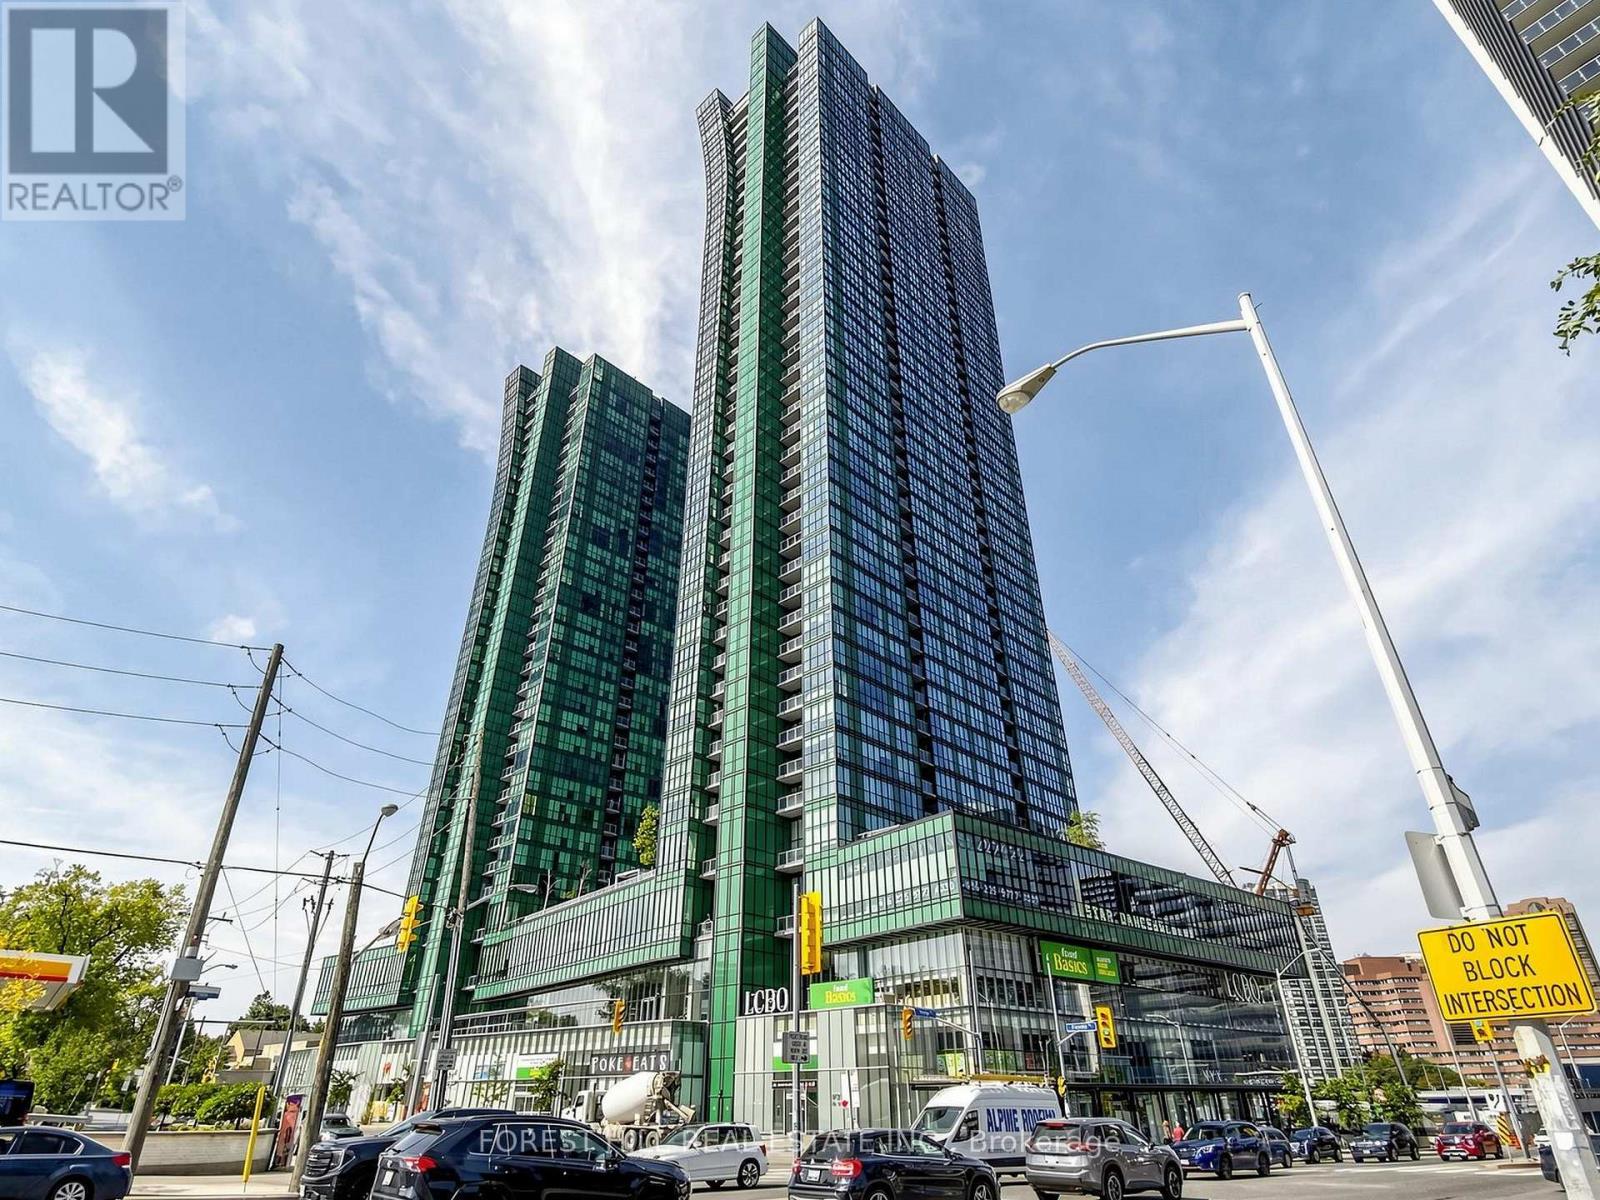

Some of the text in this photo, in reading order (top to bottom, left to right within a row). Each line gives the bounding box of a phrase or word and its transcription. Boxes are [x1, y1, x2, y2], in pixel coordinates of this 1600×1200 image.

[1447, 923, 1529, 954] DO NOT
[1053, 952, 1088, 976] Basics
[1462, 954, 1537, 982] BLOCK
[744, 986, 789, 1016] LCBO
[1223, 970, 1262, 1005] LCBO
[1443, 982, 1583, 1016] INTERSECTION
[591, 1054, 668, 1075] POKE EATS
[986, 1107, 1020, 1133] ALPINE
